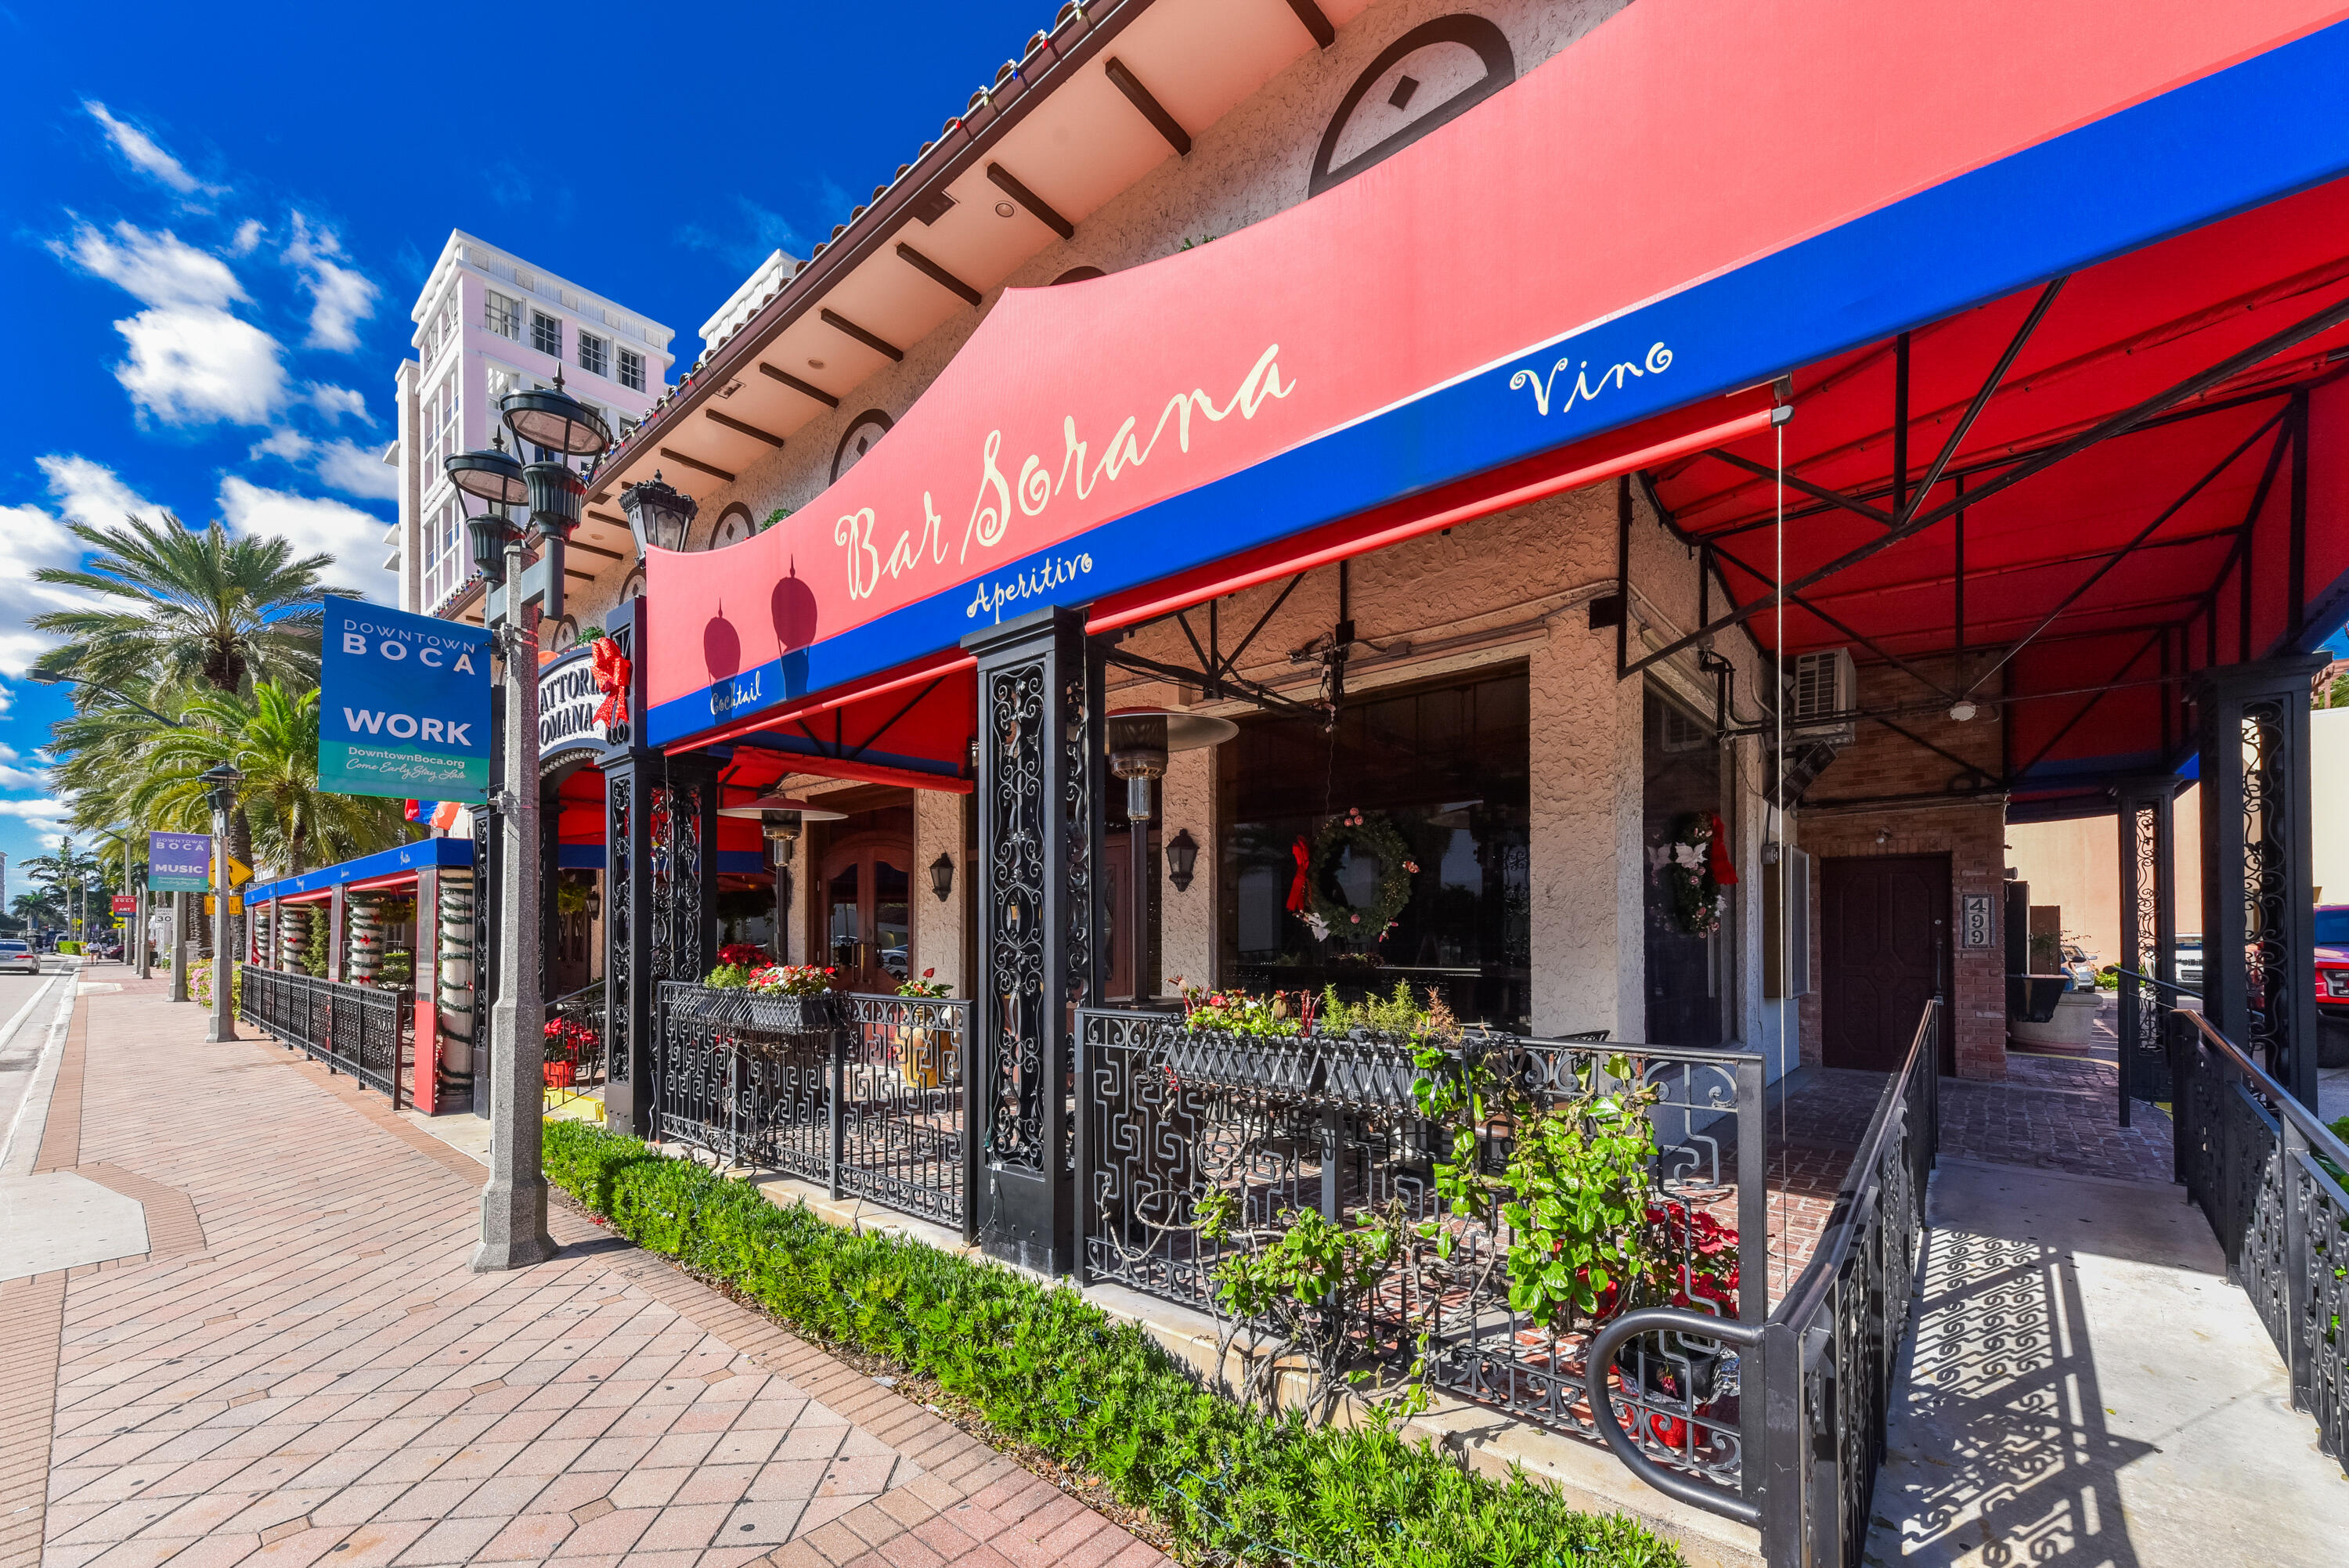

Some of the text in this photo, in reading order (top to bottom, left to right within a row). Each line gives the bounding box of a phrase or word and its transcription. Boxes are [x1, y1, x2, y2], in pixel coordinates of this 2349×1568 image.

[1510, 341, 1673, 416] Vino
[834, 343, 1297, 600] Bar Sorana
[966, 553, 1093, 625] Aperitivo
[342, 632, 476, 676] BOCA
[344, 619, 475, 654] DOWNTOWN
[539, 667, 601, 716] ATTORI
[710, 670, 762, 716] Cocktail
[343, 707, 472, 746] WORK
[539, 702, 595, 745] OMANA
[346, 758, 379, 770] Come
[410, 765, 438, 782] Stay
[438, 769, 466, 780] Late
[348, 746, 465, 770] DowntownBoca.org
[156, 842, 204, 851] BOCA
[155, 863, 204, 874] MUSIC
[1969, 898, 1986, 944] 499
